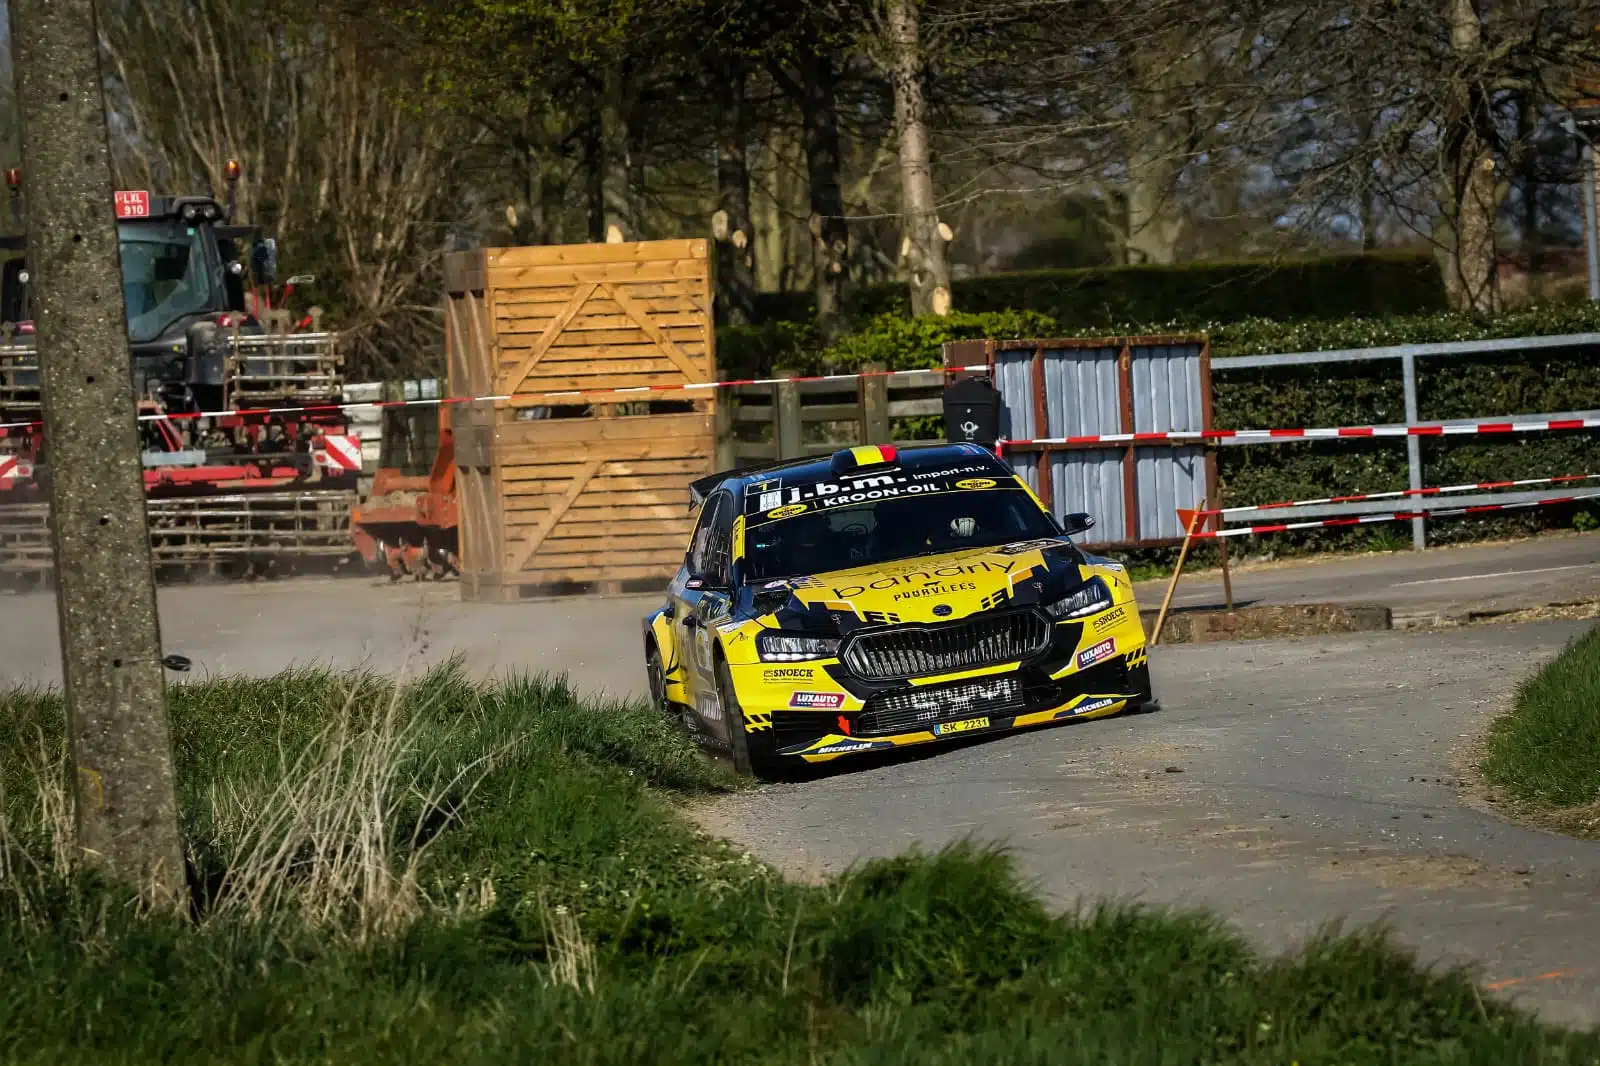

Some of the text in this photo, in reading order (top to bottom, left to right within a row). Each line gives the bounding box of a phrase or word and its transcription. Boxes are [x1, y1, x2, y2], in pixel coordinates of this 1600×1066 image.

[124, 204, 144, 216] 910
[824, 483, 940, 506] KROON-OIL
[1098, 606, 1125, 626] SNOECK
[1080, 641, 1111, 662] LUXAUTO
[773, 668, 814, 678] SNOECK
[796, 693, 839, 704] LUXAUTO
[1073, 698, 1113, 715] MICHELIN
[942, 718, 988, 733] SK 2231
[817, 742, 873, 754] MICHELIN
